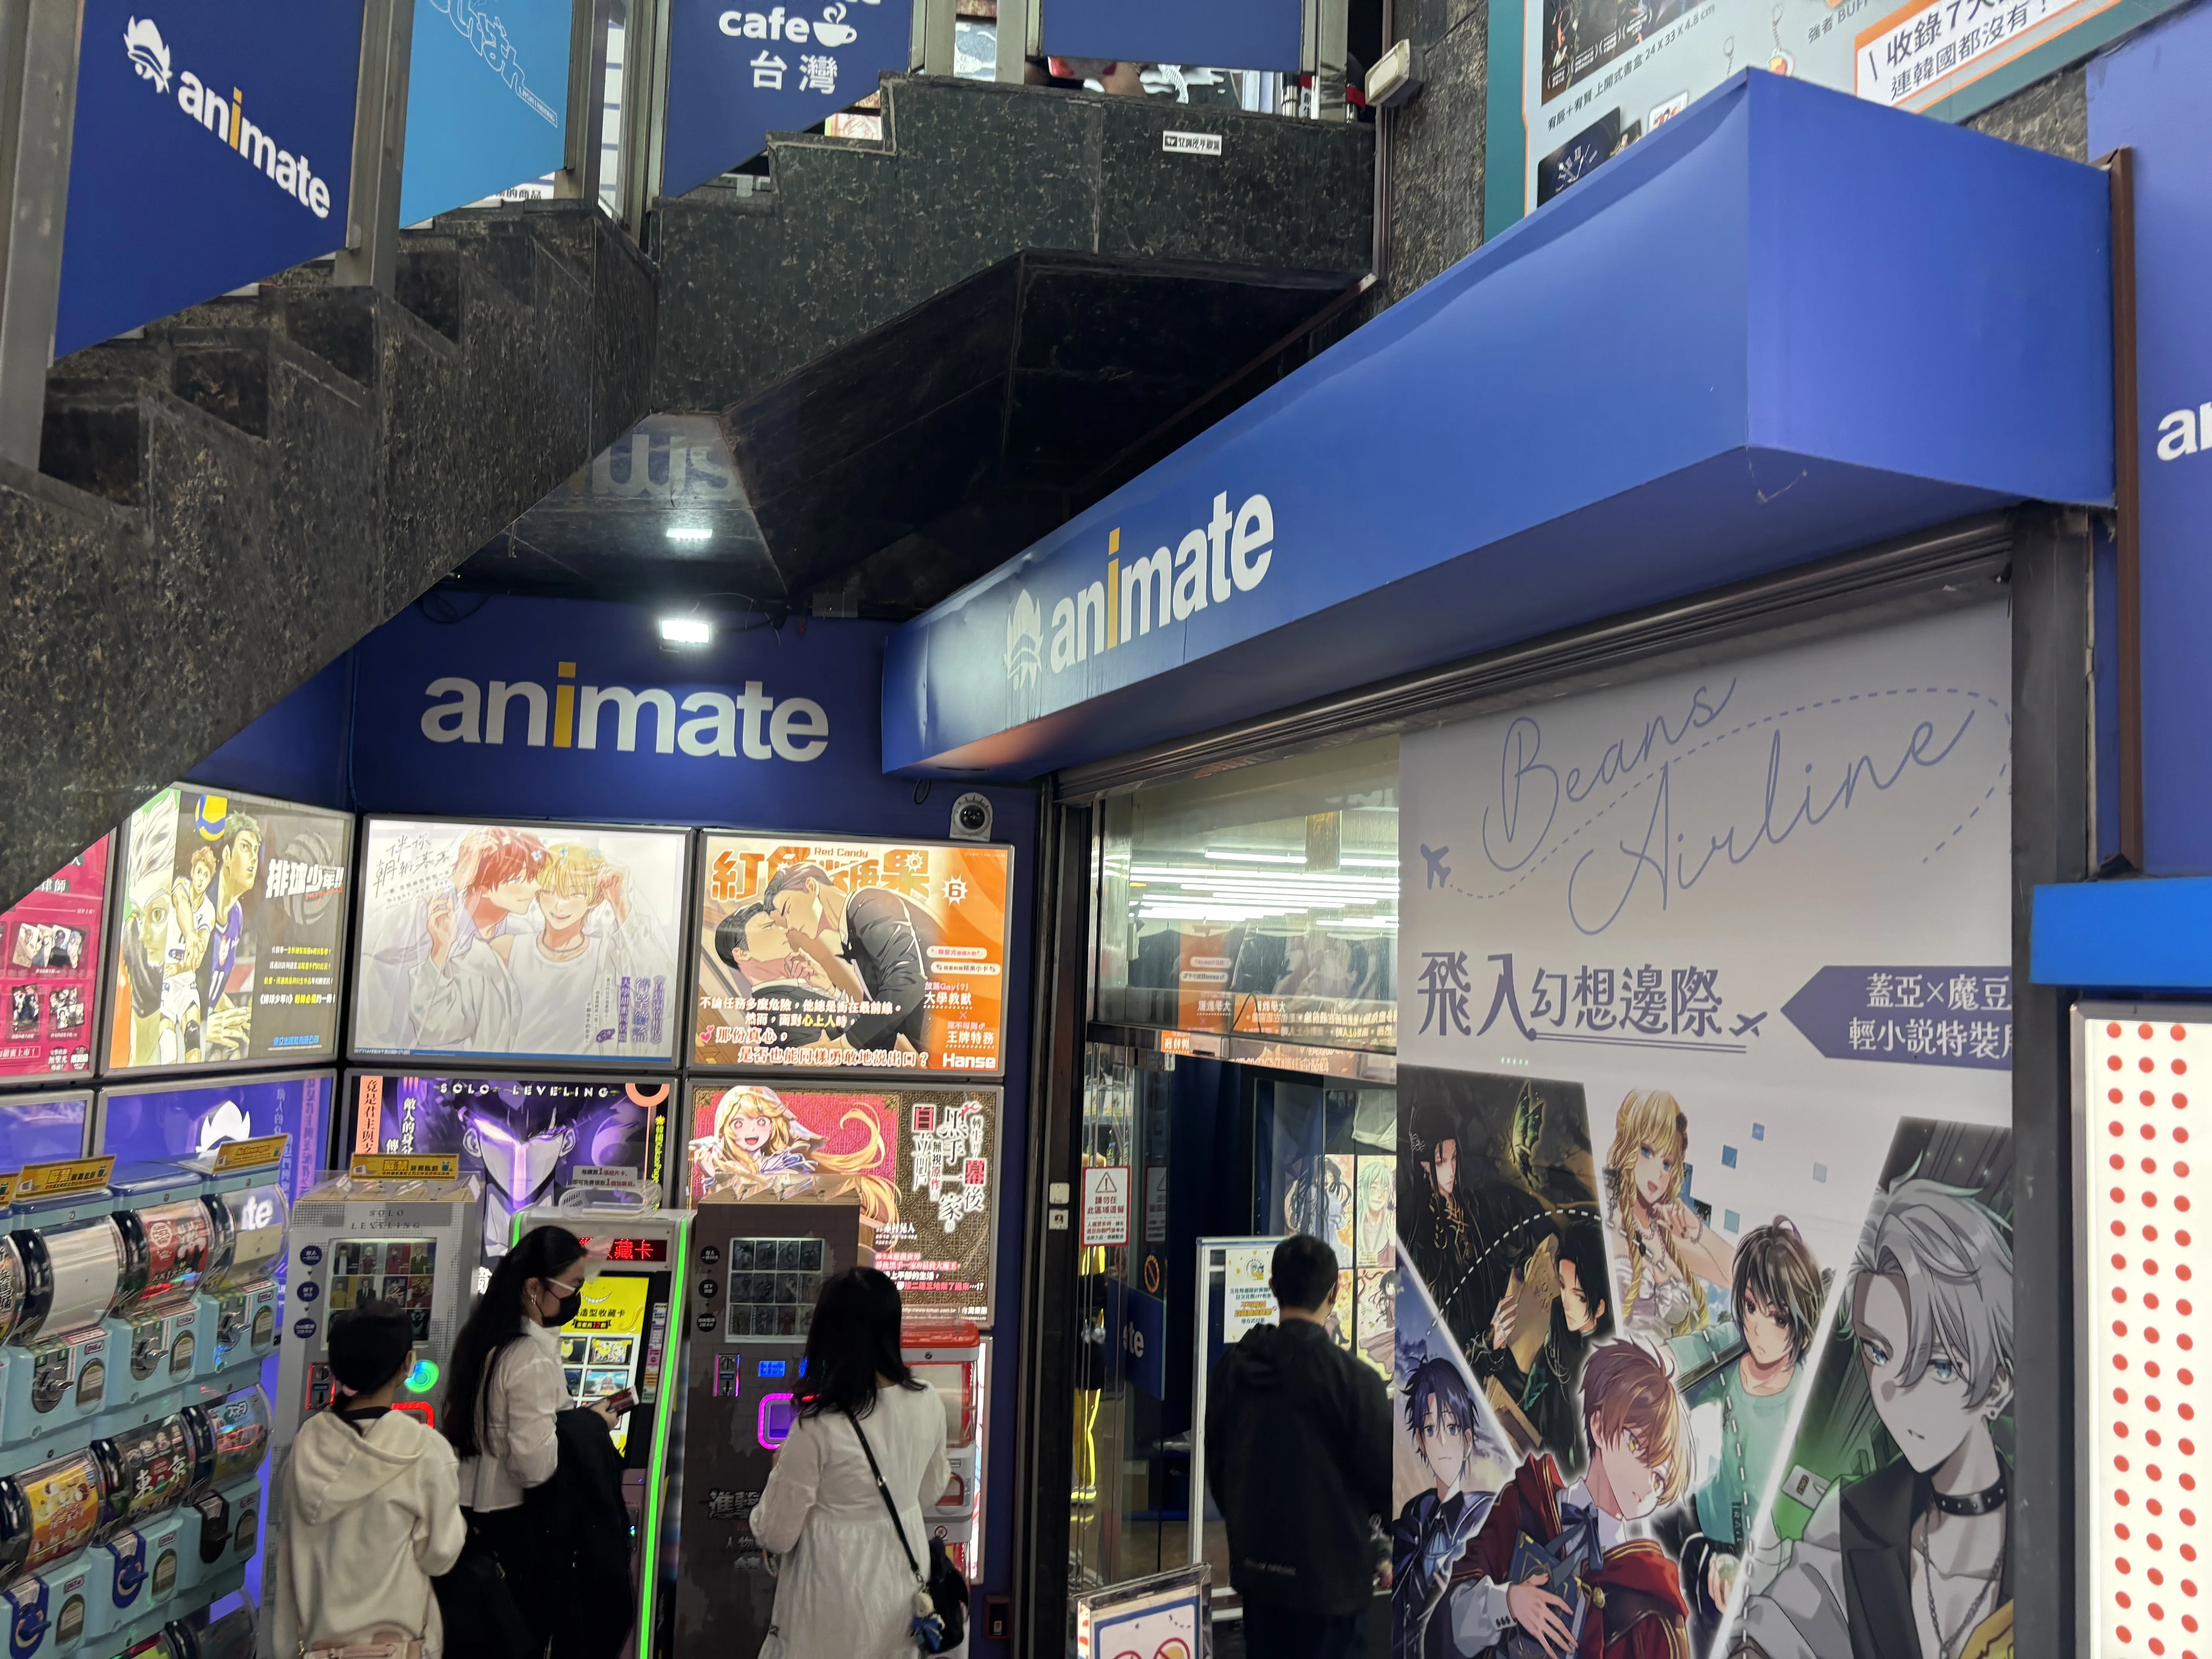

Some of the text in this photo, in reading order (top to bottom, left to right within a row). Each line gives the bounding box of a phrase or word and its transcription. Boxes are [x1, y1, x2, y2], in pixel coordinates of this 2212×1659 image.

[718, 10, 810, 43] cafe
[750, 50, 838, 95] 台灣
[178, 71, 330, 218] animate
[1050, 490, 1274, 673] animate
[421, 661, 829, 762] animate
[1482, 677, 1736, 872] Beans
[1568, 709, 1976, 936] Airline
[814, 847, 869, 859] Red Candy
[265, 858, 345, 899] 排球少年!!
[949, 882, 960, 897] 6
[1417, 950, 1723, 1042] 飛入幻想邊際
[942, 1052, 996, 1069] Hanse
[440, 1082, 609, 1098] SOLO LEVELING
[608, 1239, 654, 1260] 藏卡
